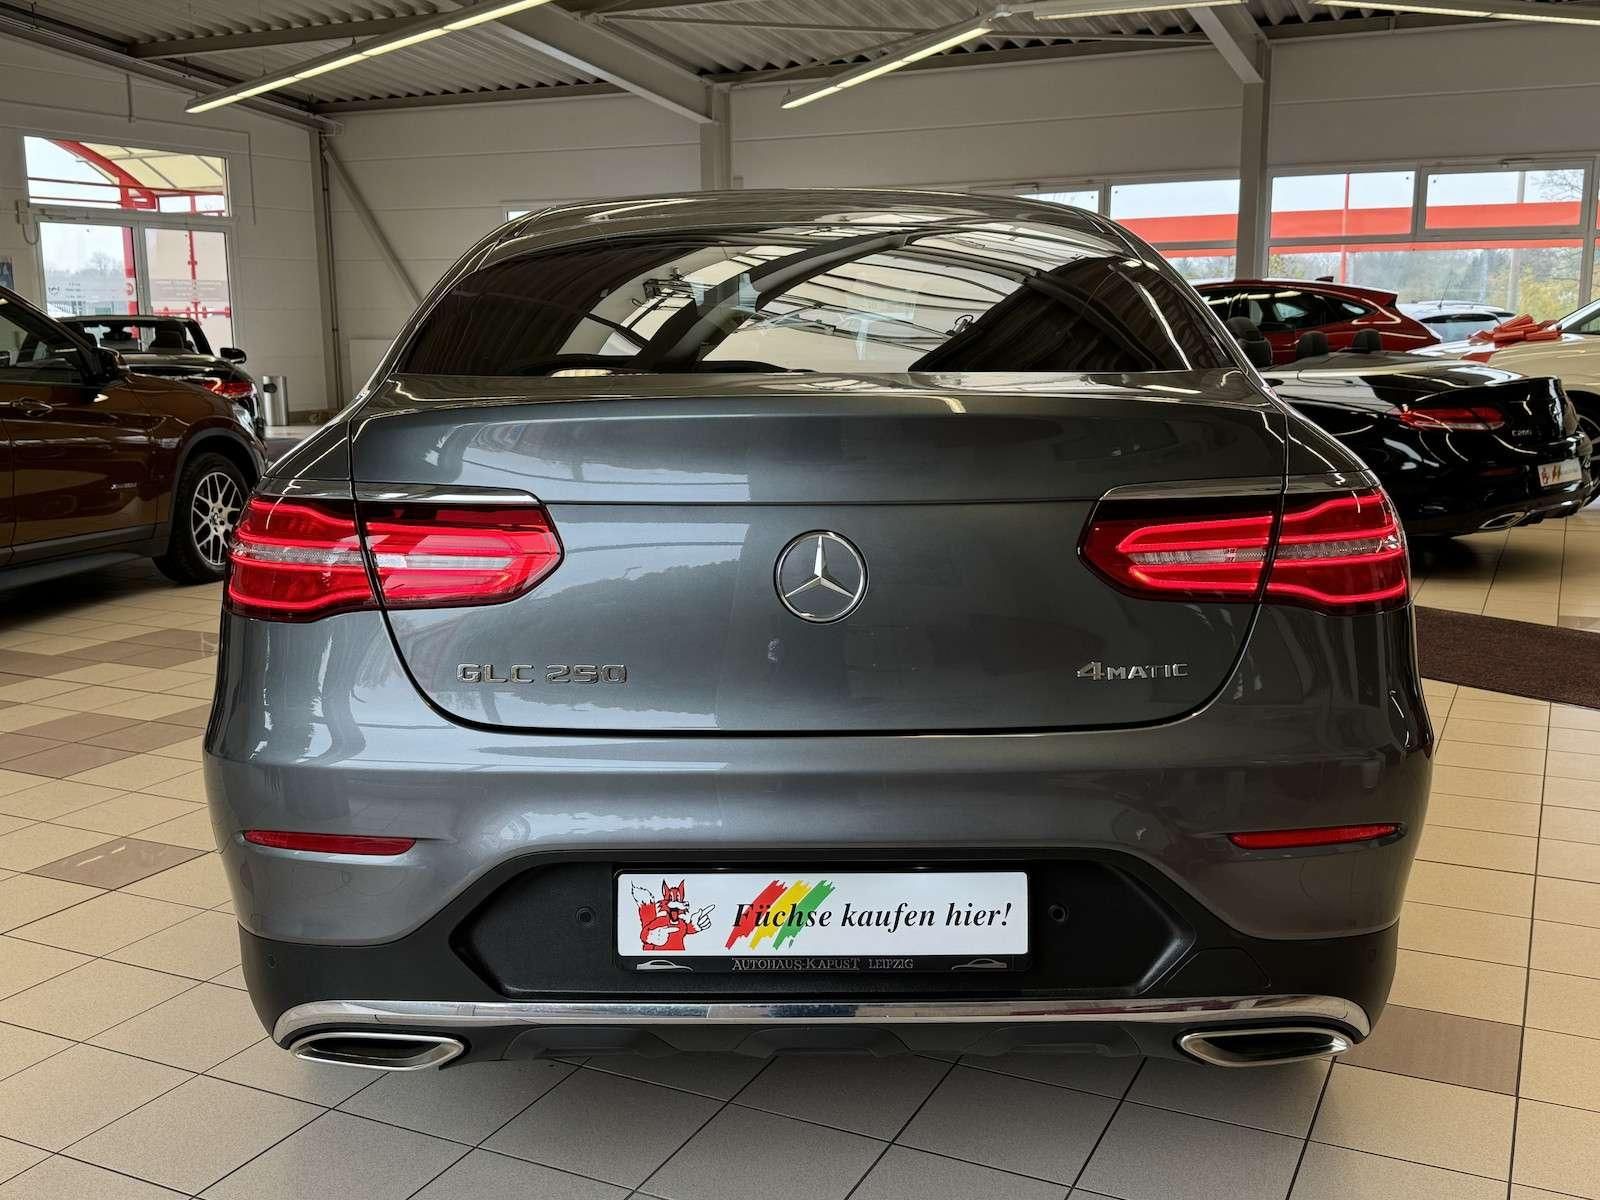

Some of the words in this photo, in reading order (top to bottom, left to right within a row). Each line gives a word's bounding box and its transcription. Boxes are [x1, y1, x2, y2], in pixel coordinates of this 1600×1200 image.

[457, 664, 534, 683] GLC
[546, 664, 627, 683] 250
[1077, 661, 1189, 680] 4MATIC
[733, 903, 832, 927] Füchse
[841, 902, 936, 933] kaufen
[945, 902, 1012, 926] hier!
[869, 959, 913, 969] LEIPZIG
